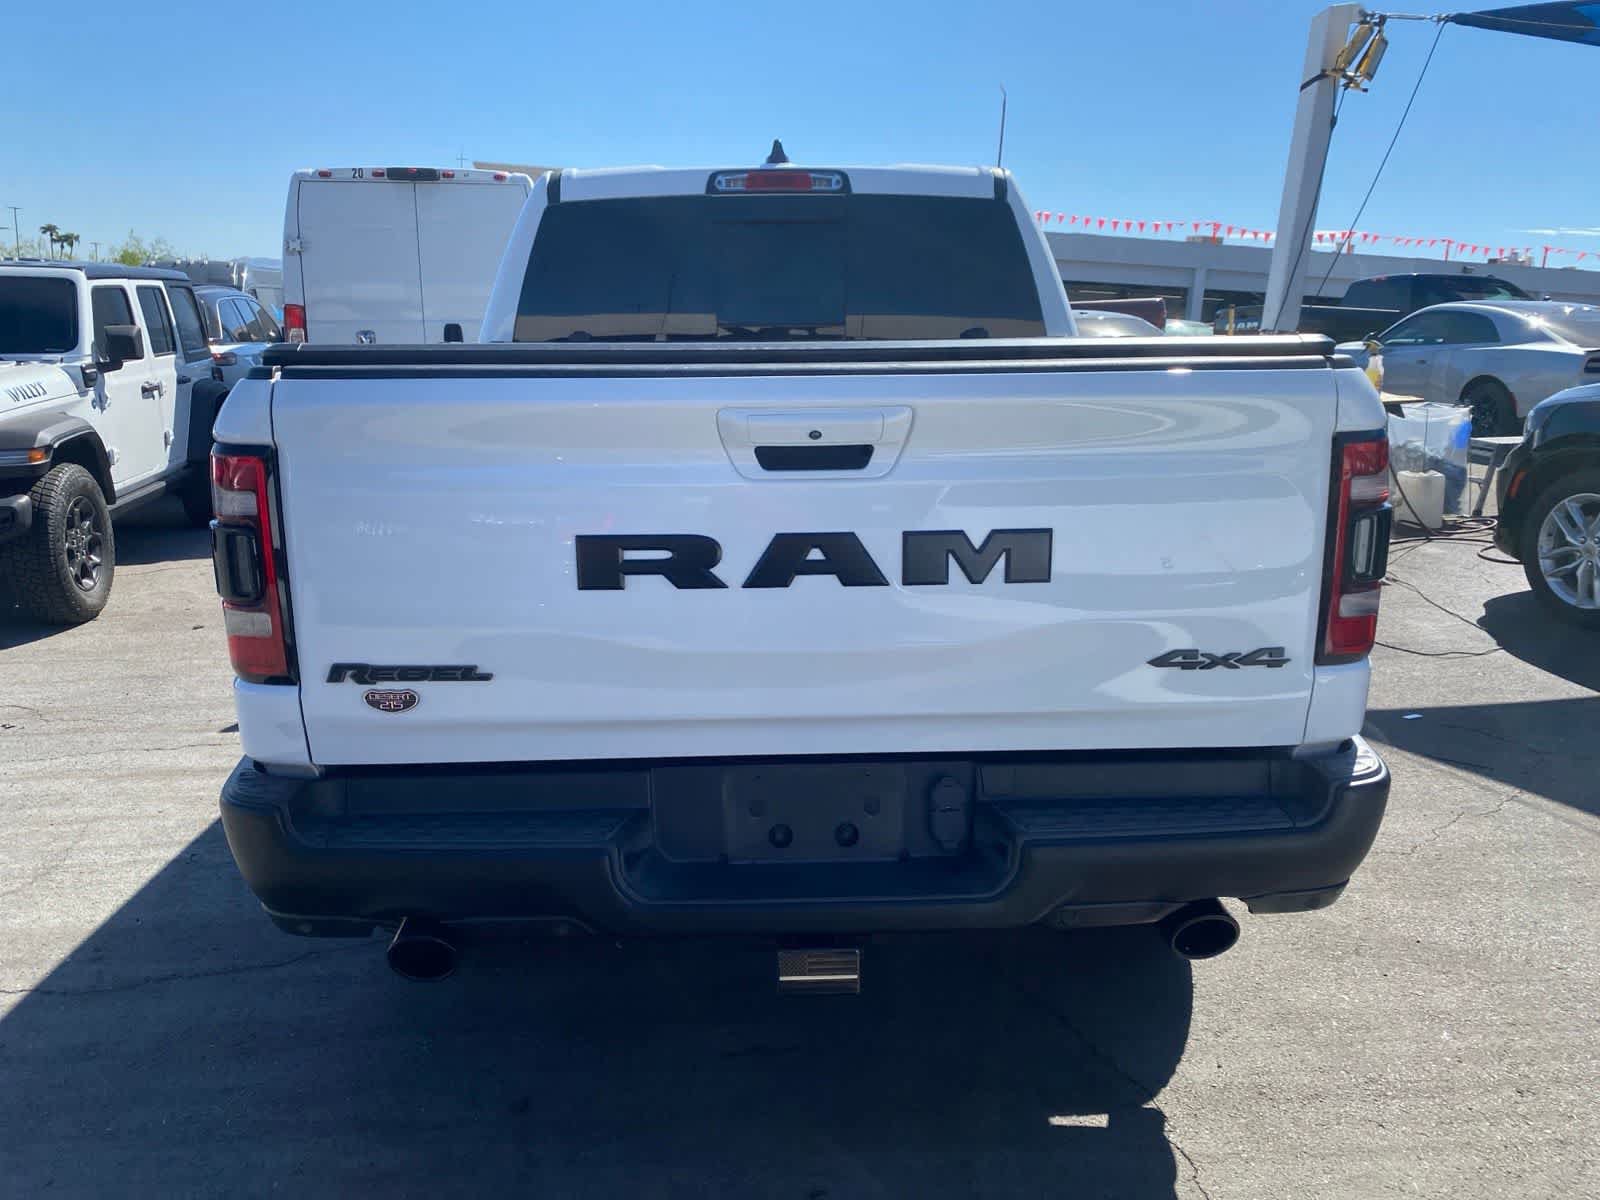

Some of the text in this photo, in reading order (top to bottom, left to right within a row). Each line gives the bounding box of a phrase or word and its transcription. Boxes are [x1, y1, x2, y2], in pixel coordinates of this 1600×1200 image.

[352, 168, 364, 179] 20
[8, 382, 48, 402] WILLYS
[575, 528, 1052, 590] RAM
[326, 663, 494, 685] REBEL
[380, 701, 404, 710] 215
